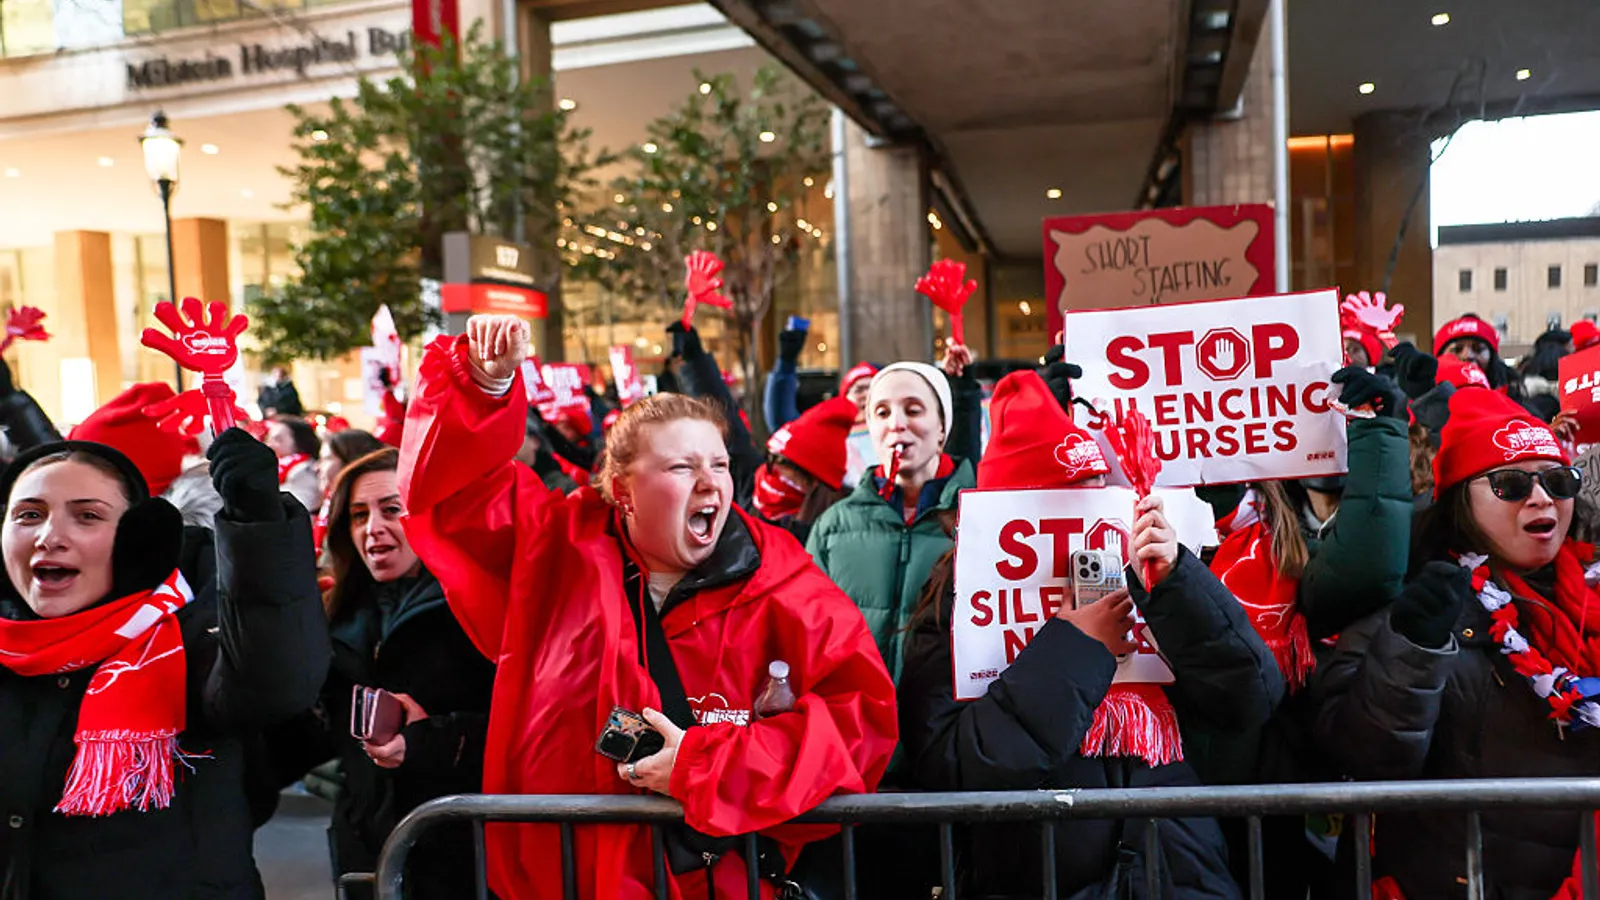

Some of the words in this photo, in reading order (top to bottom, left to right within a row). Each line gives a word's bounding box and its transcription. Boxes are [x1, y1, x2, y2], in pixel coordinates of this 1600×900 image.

[240, 31, 356, 79] Hospital
[1081, 234, 1151, 275] SHORT
[1131, 258, 1232, 297] STAFFING
[1154, 420, 1299, 462] URSES
